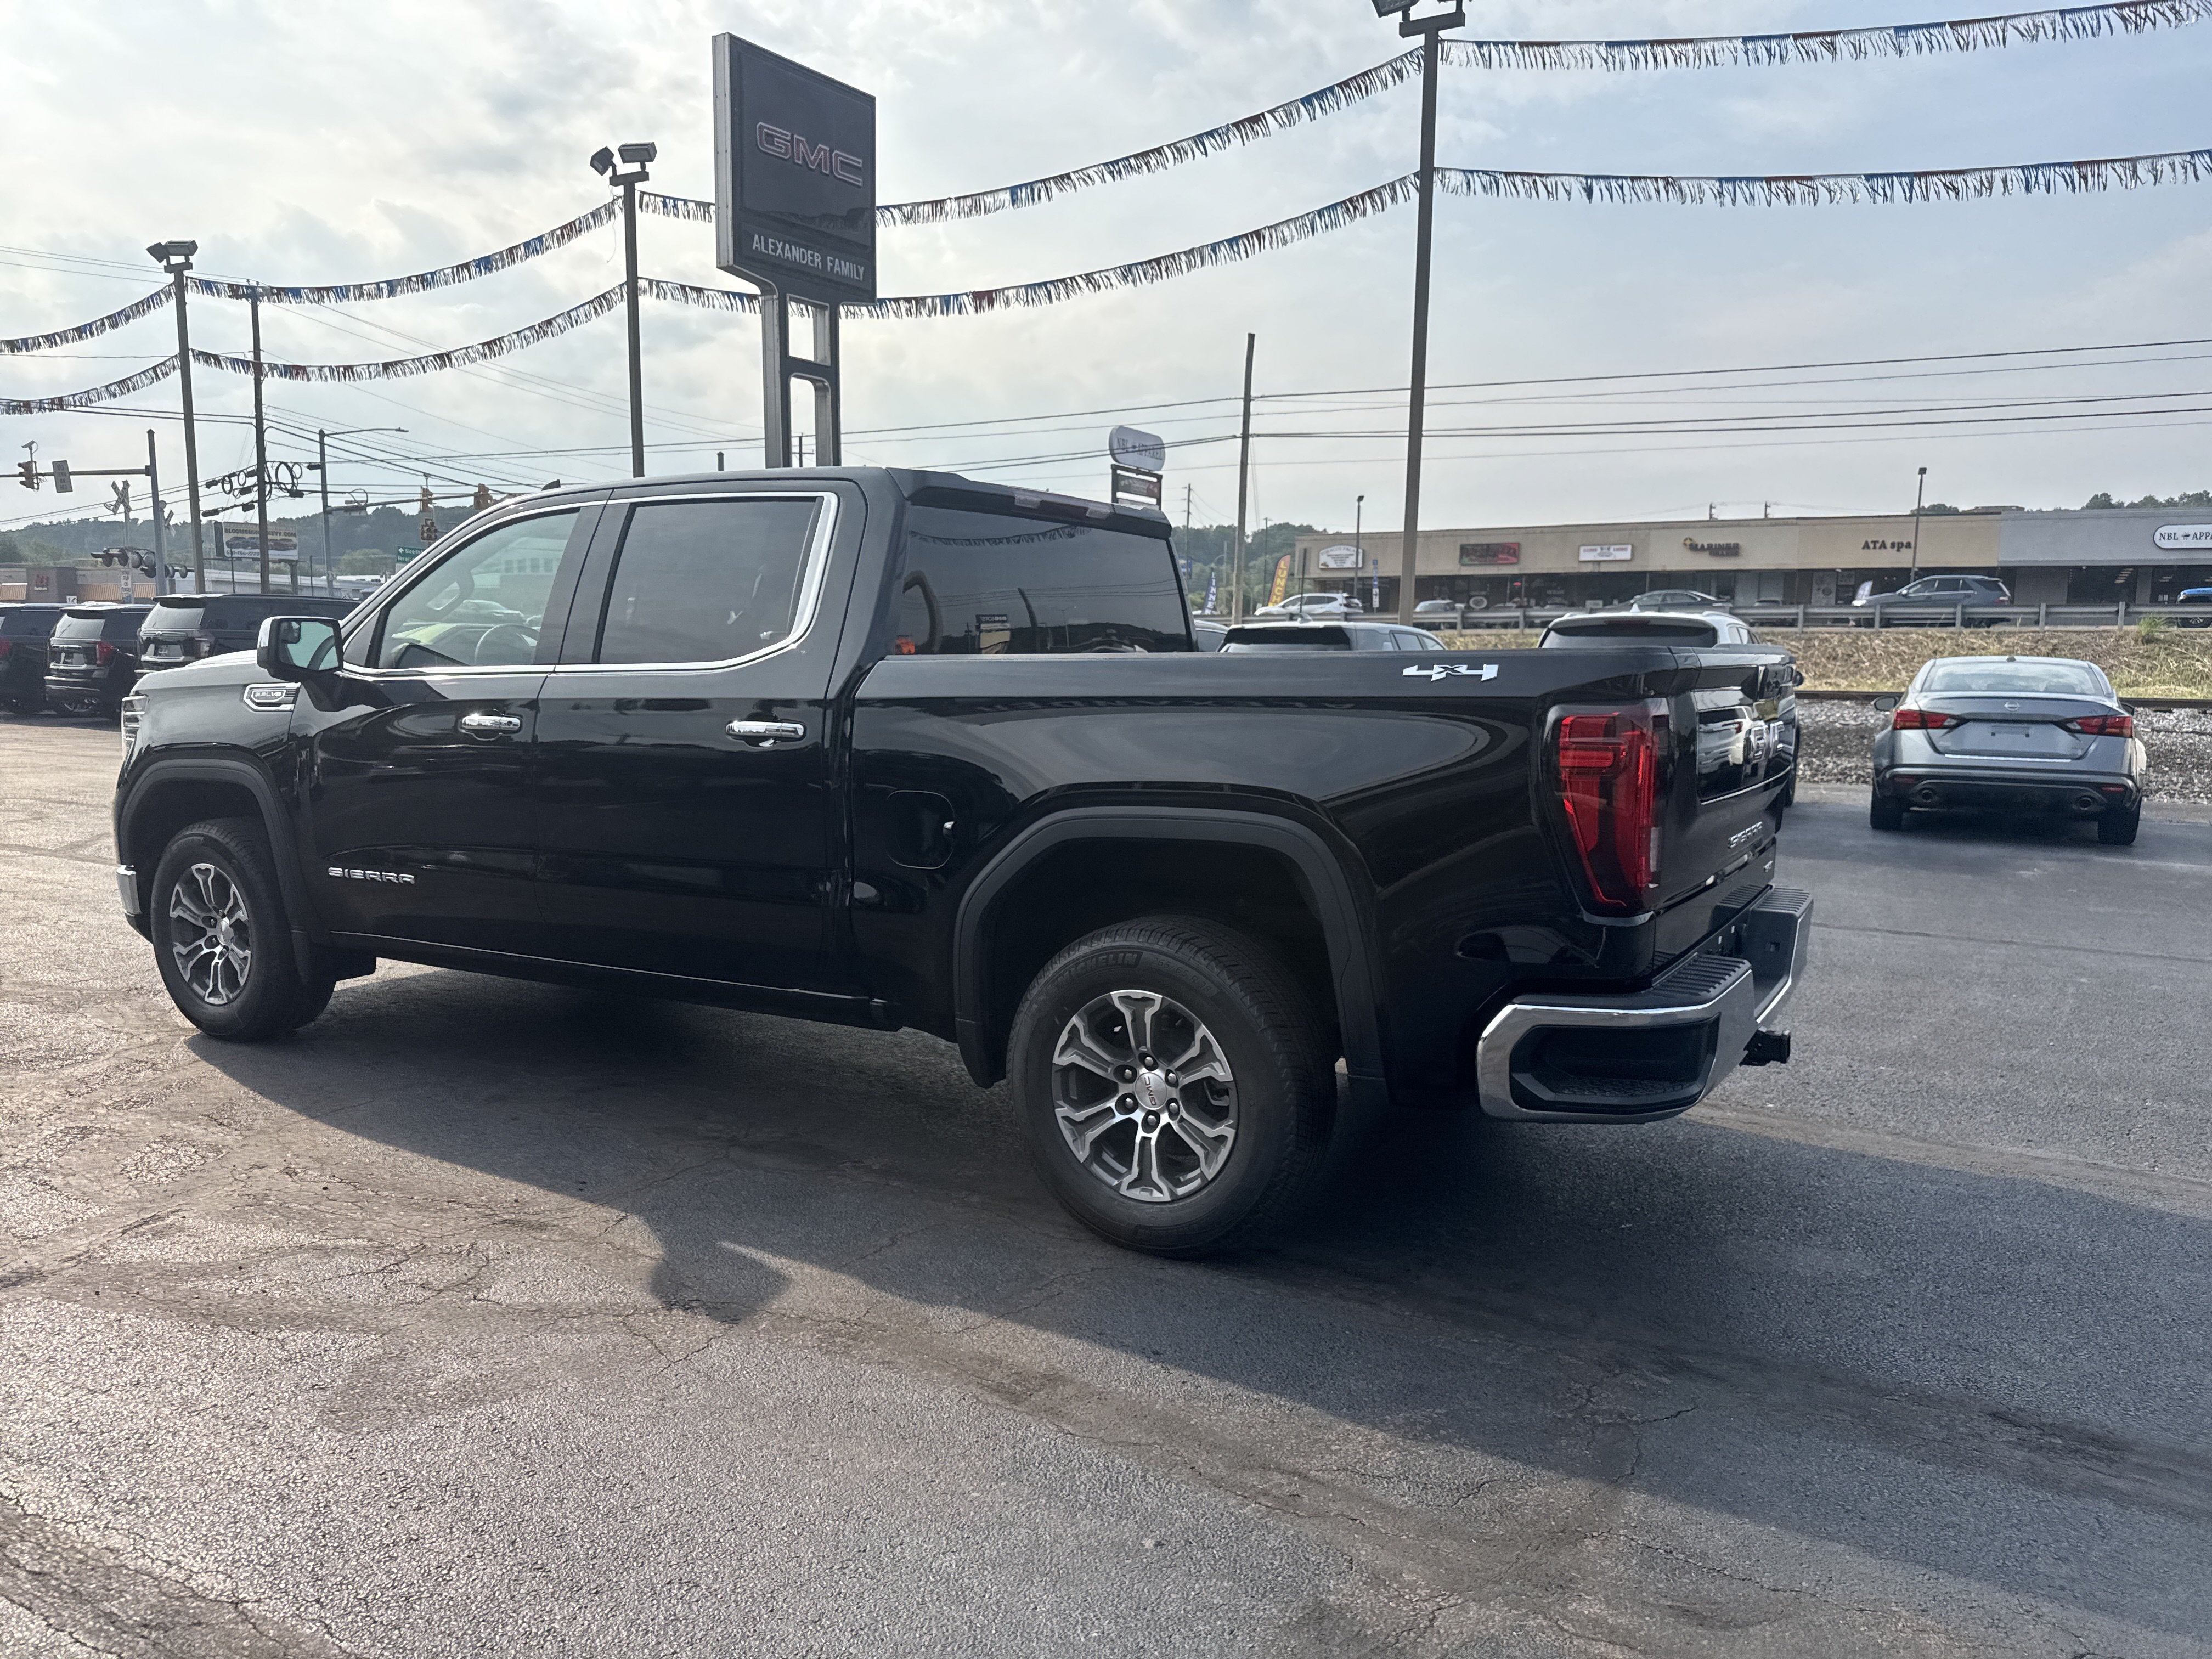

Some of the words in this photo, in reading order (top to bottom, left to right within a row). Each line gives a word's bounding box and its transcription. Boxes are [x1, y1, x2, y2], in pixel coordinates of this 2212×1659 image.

[756, 122, 863, 187] GMC
[752, 234, 822, 270] ALEXANDER
[827, 256, 865, 282] FAMILY
[1861, 540, 1888, 550] ATA
[1890, 541, 1912, 552] spa
[2158, 532, 2179, 541] NBL
[1272, 561, 1287, 603] LUNCH
[1728, 821, 1763, 848] SIERRA
[328, 867, 416, 884] SIERRA
[1144, 1076, 1157, 1106] GMC
